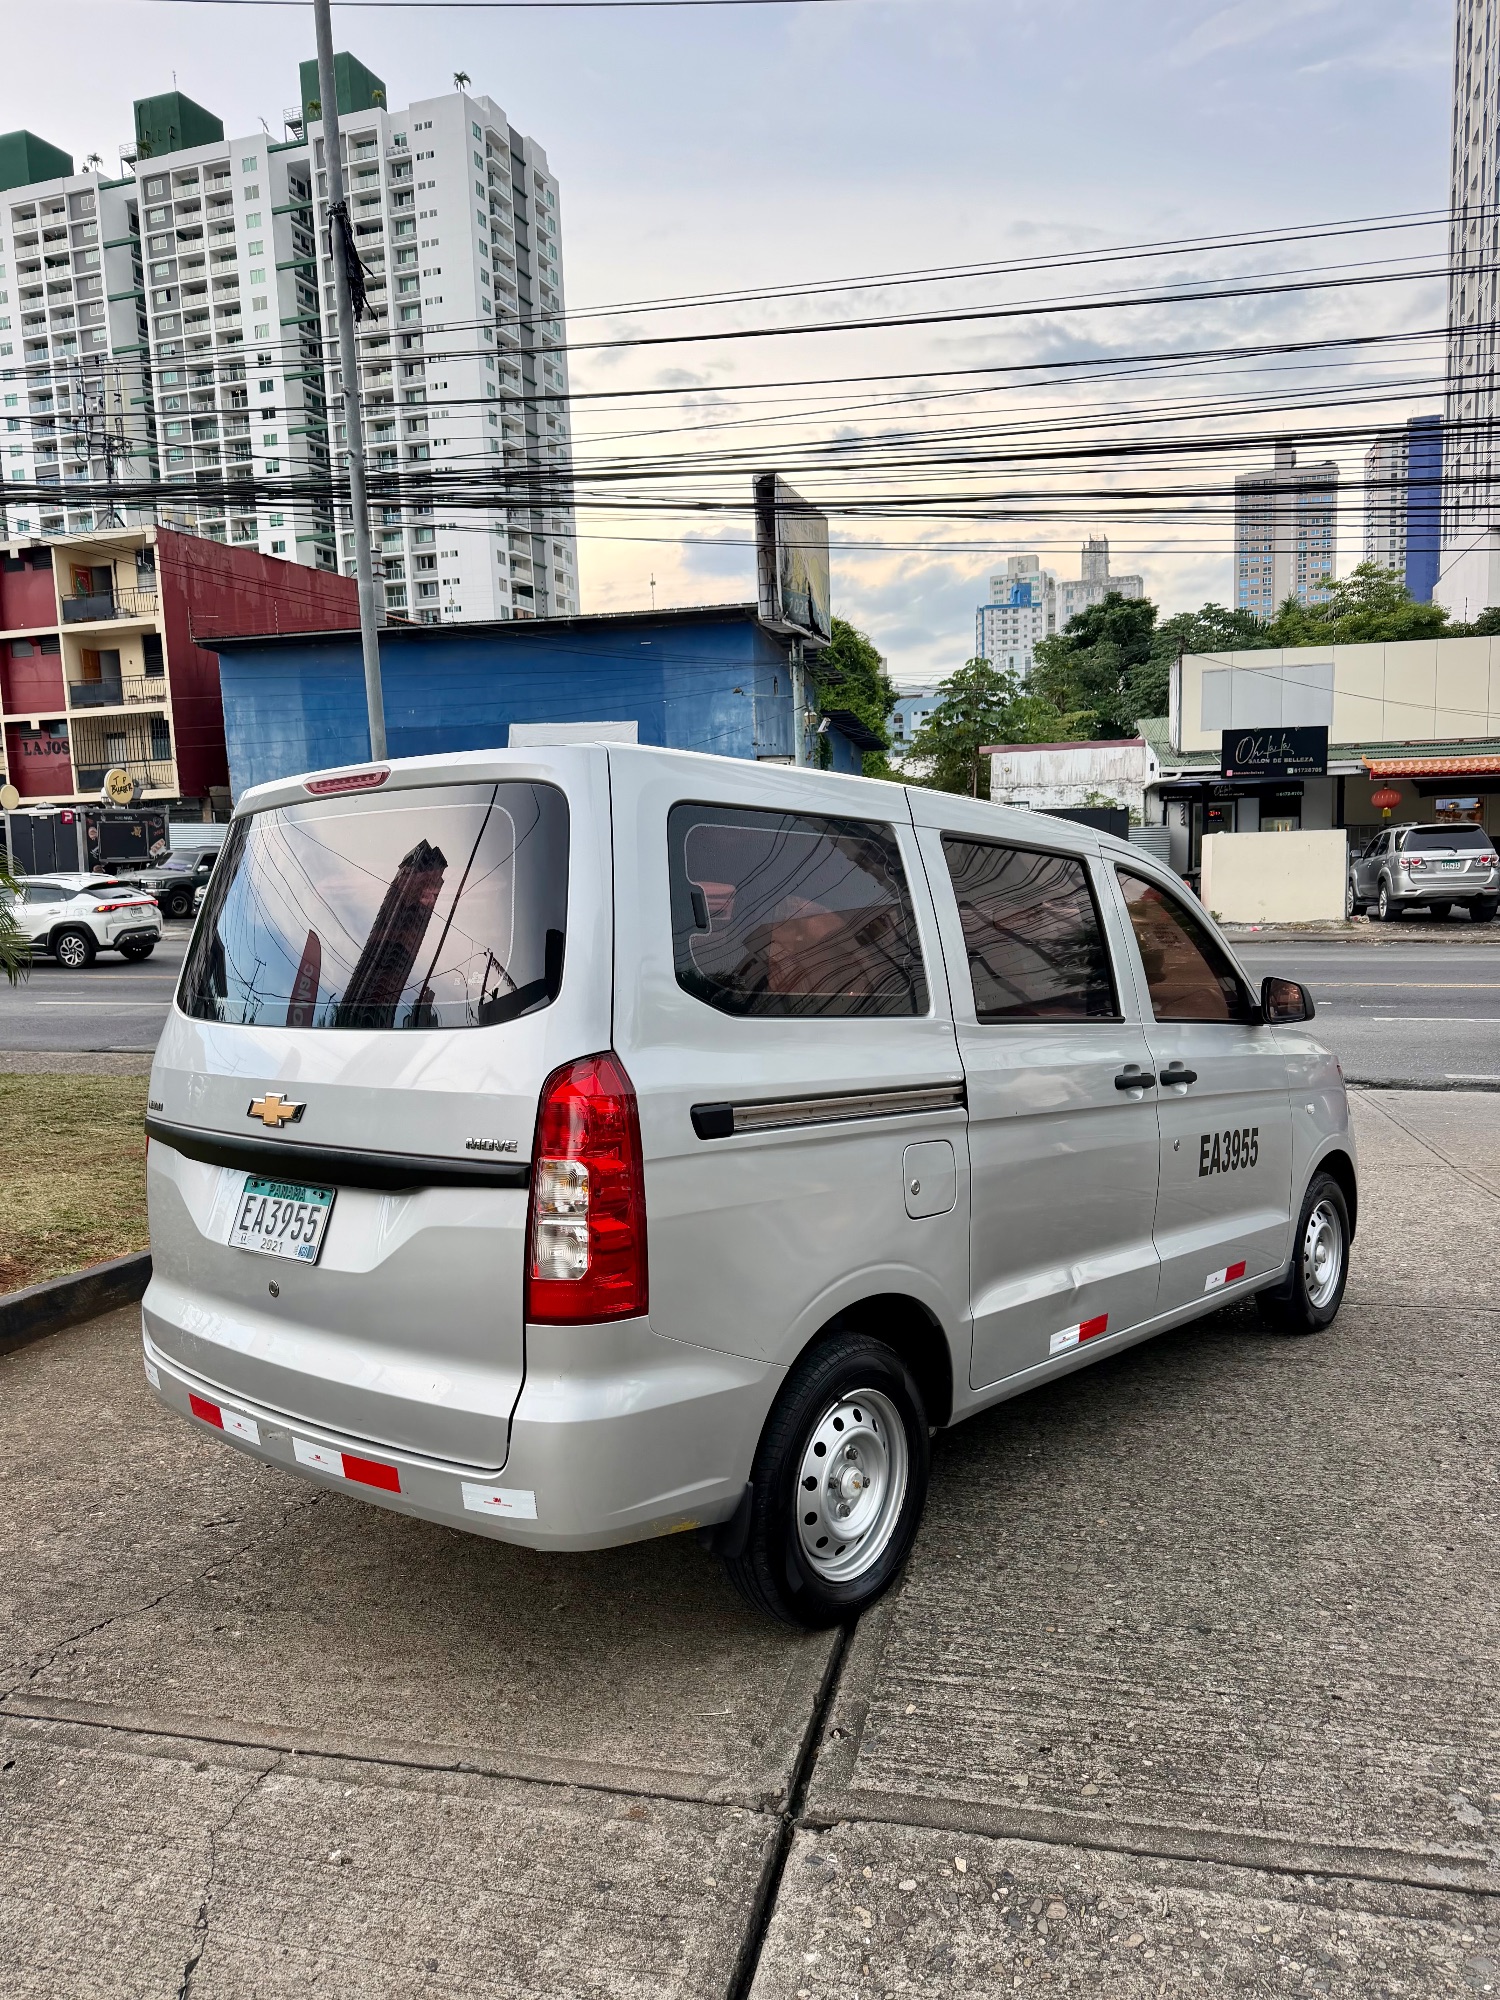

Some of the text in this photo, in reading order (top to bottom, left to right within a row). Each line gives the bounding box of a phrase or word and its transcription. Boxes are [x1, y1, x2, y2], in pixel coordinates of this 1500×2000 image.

[465, 1137, 518, 1153] MOVE
[1198, 1127, 1259, 1177] EA3955
[268, 1183, 306, 1203] PANAMA
[239, 1195, 322, 1243] EA3955
[260, 1237, 284, 1253] 2021
